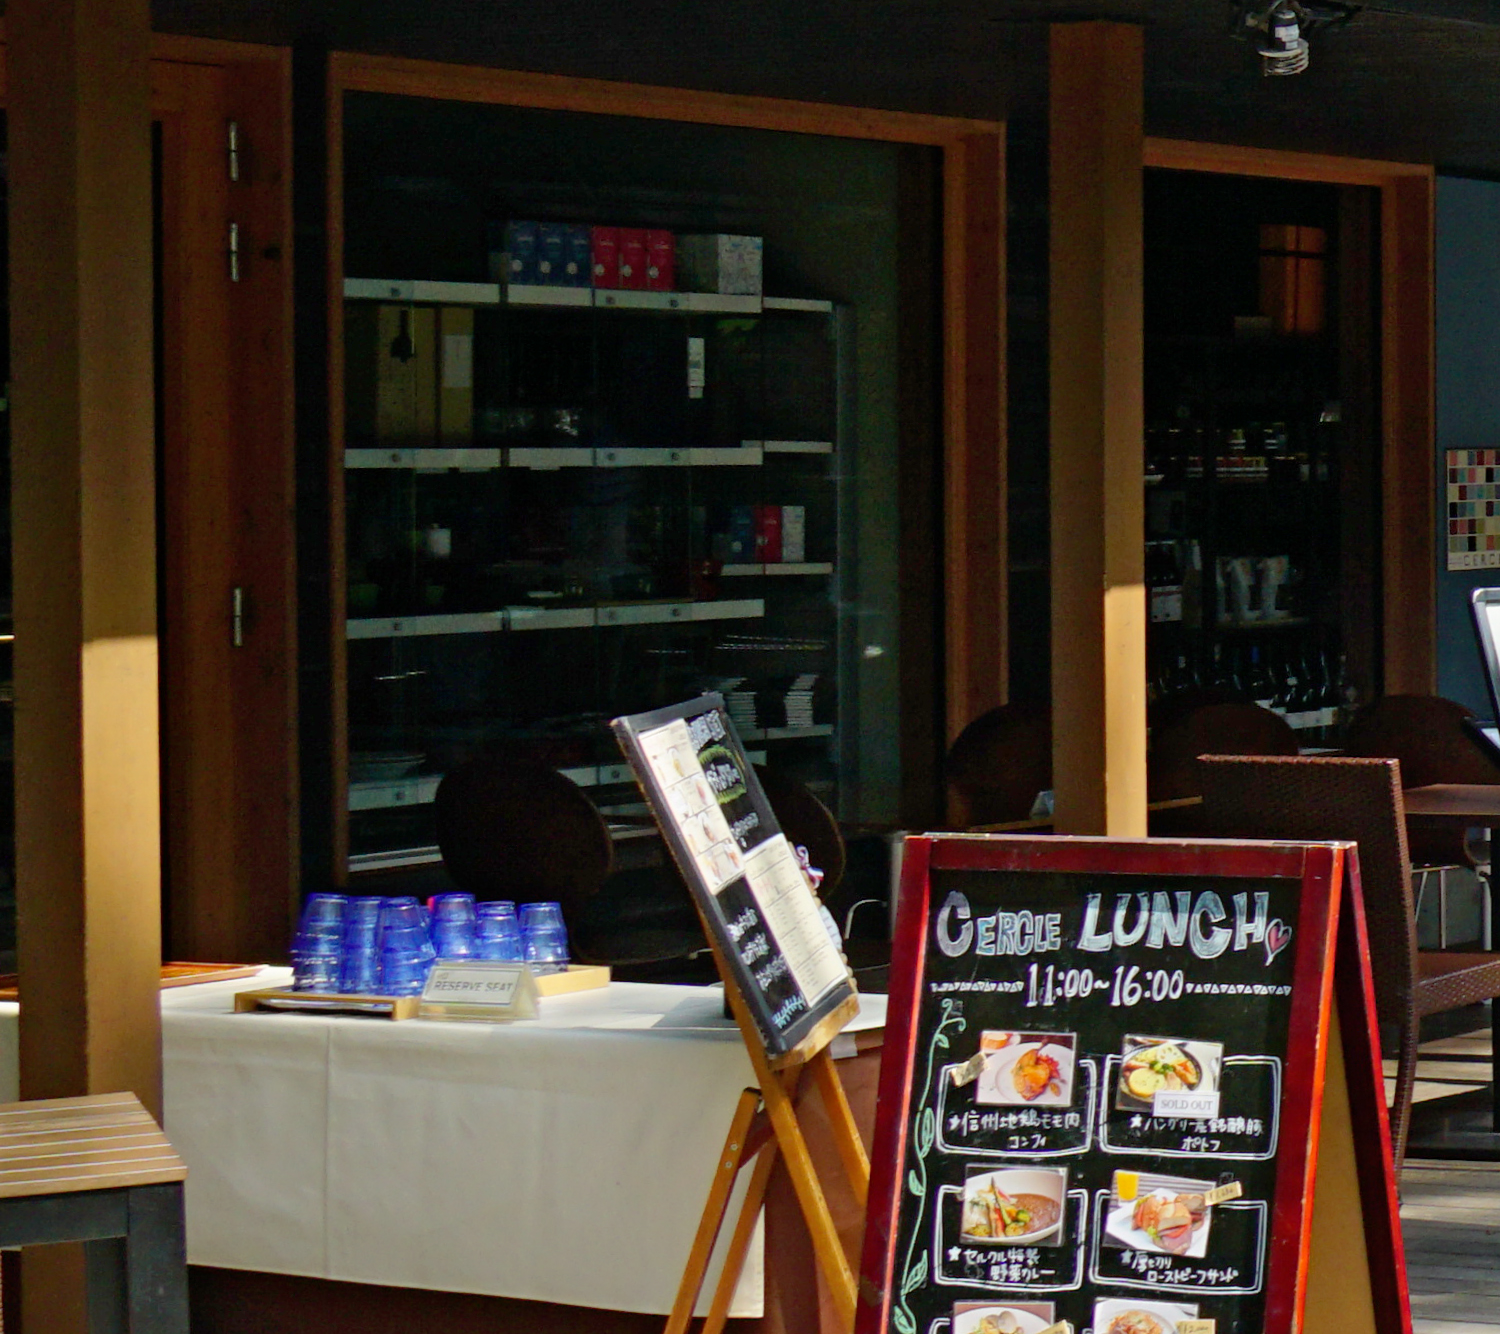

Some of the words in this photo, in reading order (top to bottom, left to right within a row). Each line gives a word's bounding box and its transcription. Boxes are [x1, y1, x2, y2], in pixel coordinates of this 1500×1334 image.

[1076, 890, 1270, 960] LUNCH
[1161, 1099, 1187, 1112] SOLD
[1190, 1099, 1213, 1111] OUT
[1181, 1135, 1221, 1152] ポトフ
